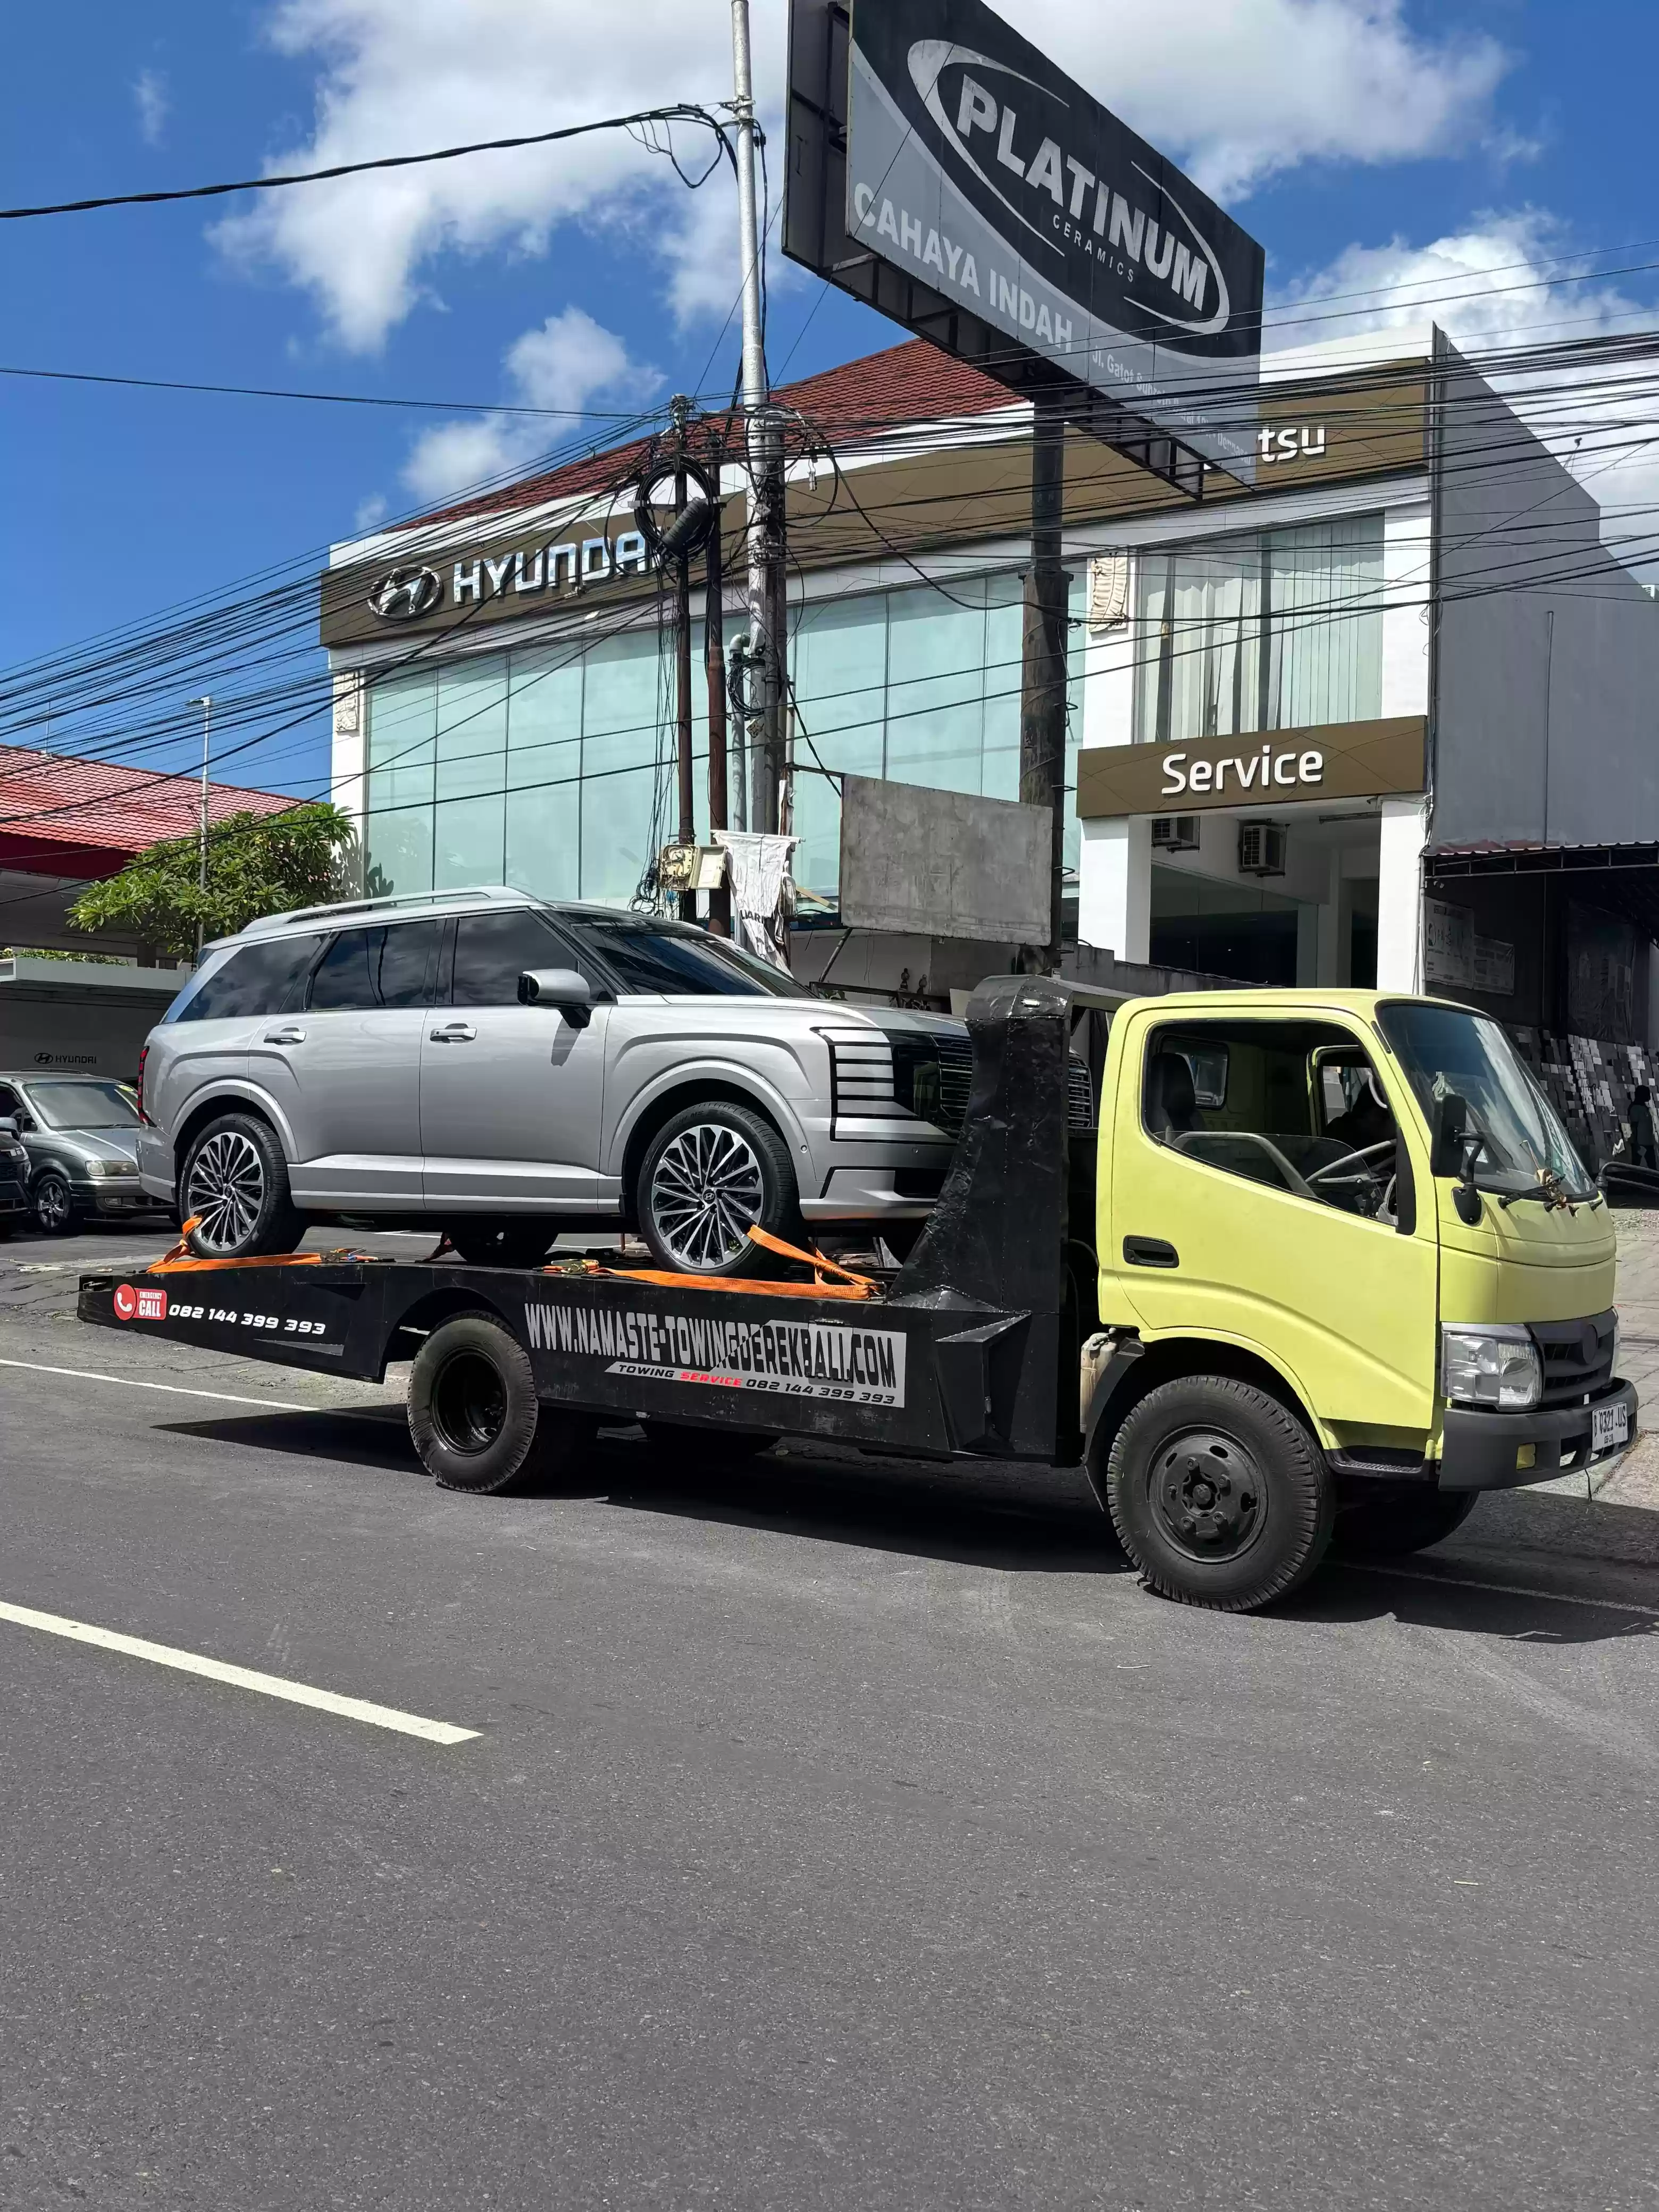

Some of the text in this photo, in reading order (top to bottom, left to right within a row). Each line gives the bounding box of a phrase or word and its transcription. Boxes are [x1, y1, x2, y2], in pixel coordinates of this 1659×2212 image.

[957, 74, 1208, 311] PLATINUM
[854, 182, 1072, 353] CAHAYA INDAH
[1053, 214, 1134, 283] CERAMICS
[1107, 354, 1134, 386] Gatot
[1161, 745, 1323, 794] Service
[55, 1054, 96, 1064] HYUNDAI
[139, 1300, 161, 1317] CALL
[169, 1304, 326, 1335] 082 144 399 393
[618, 1364, 895, 1404] TOWING SERVICE 082 144 399 393
